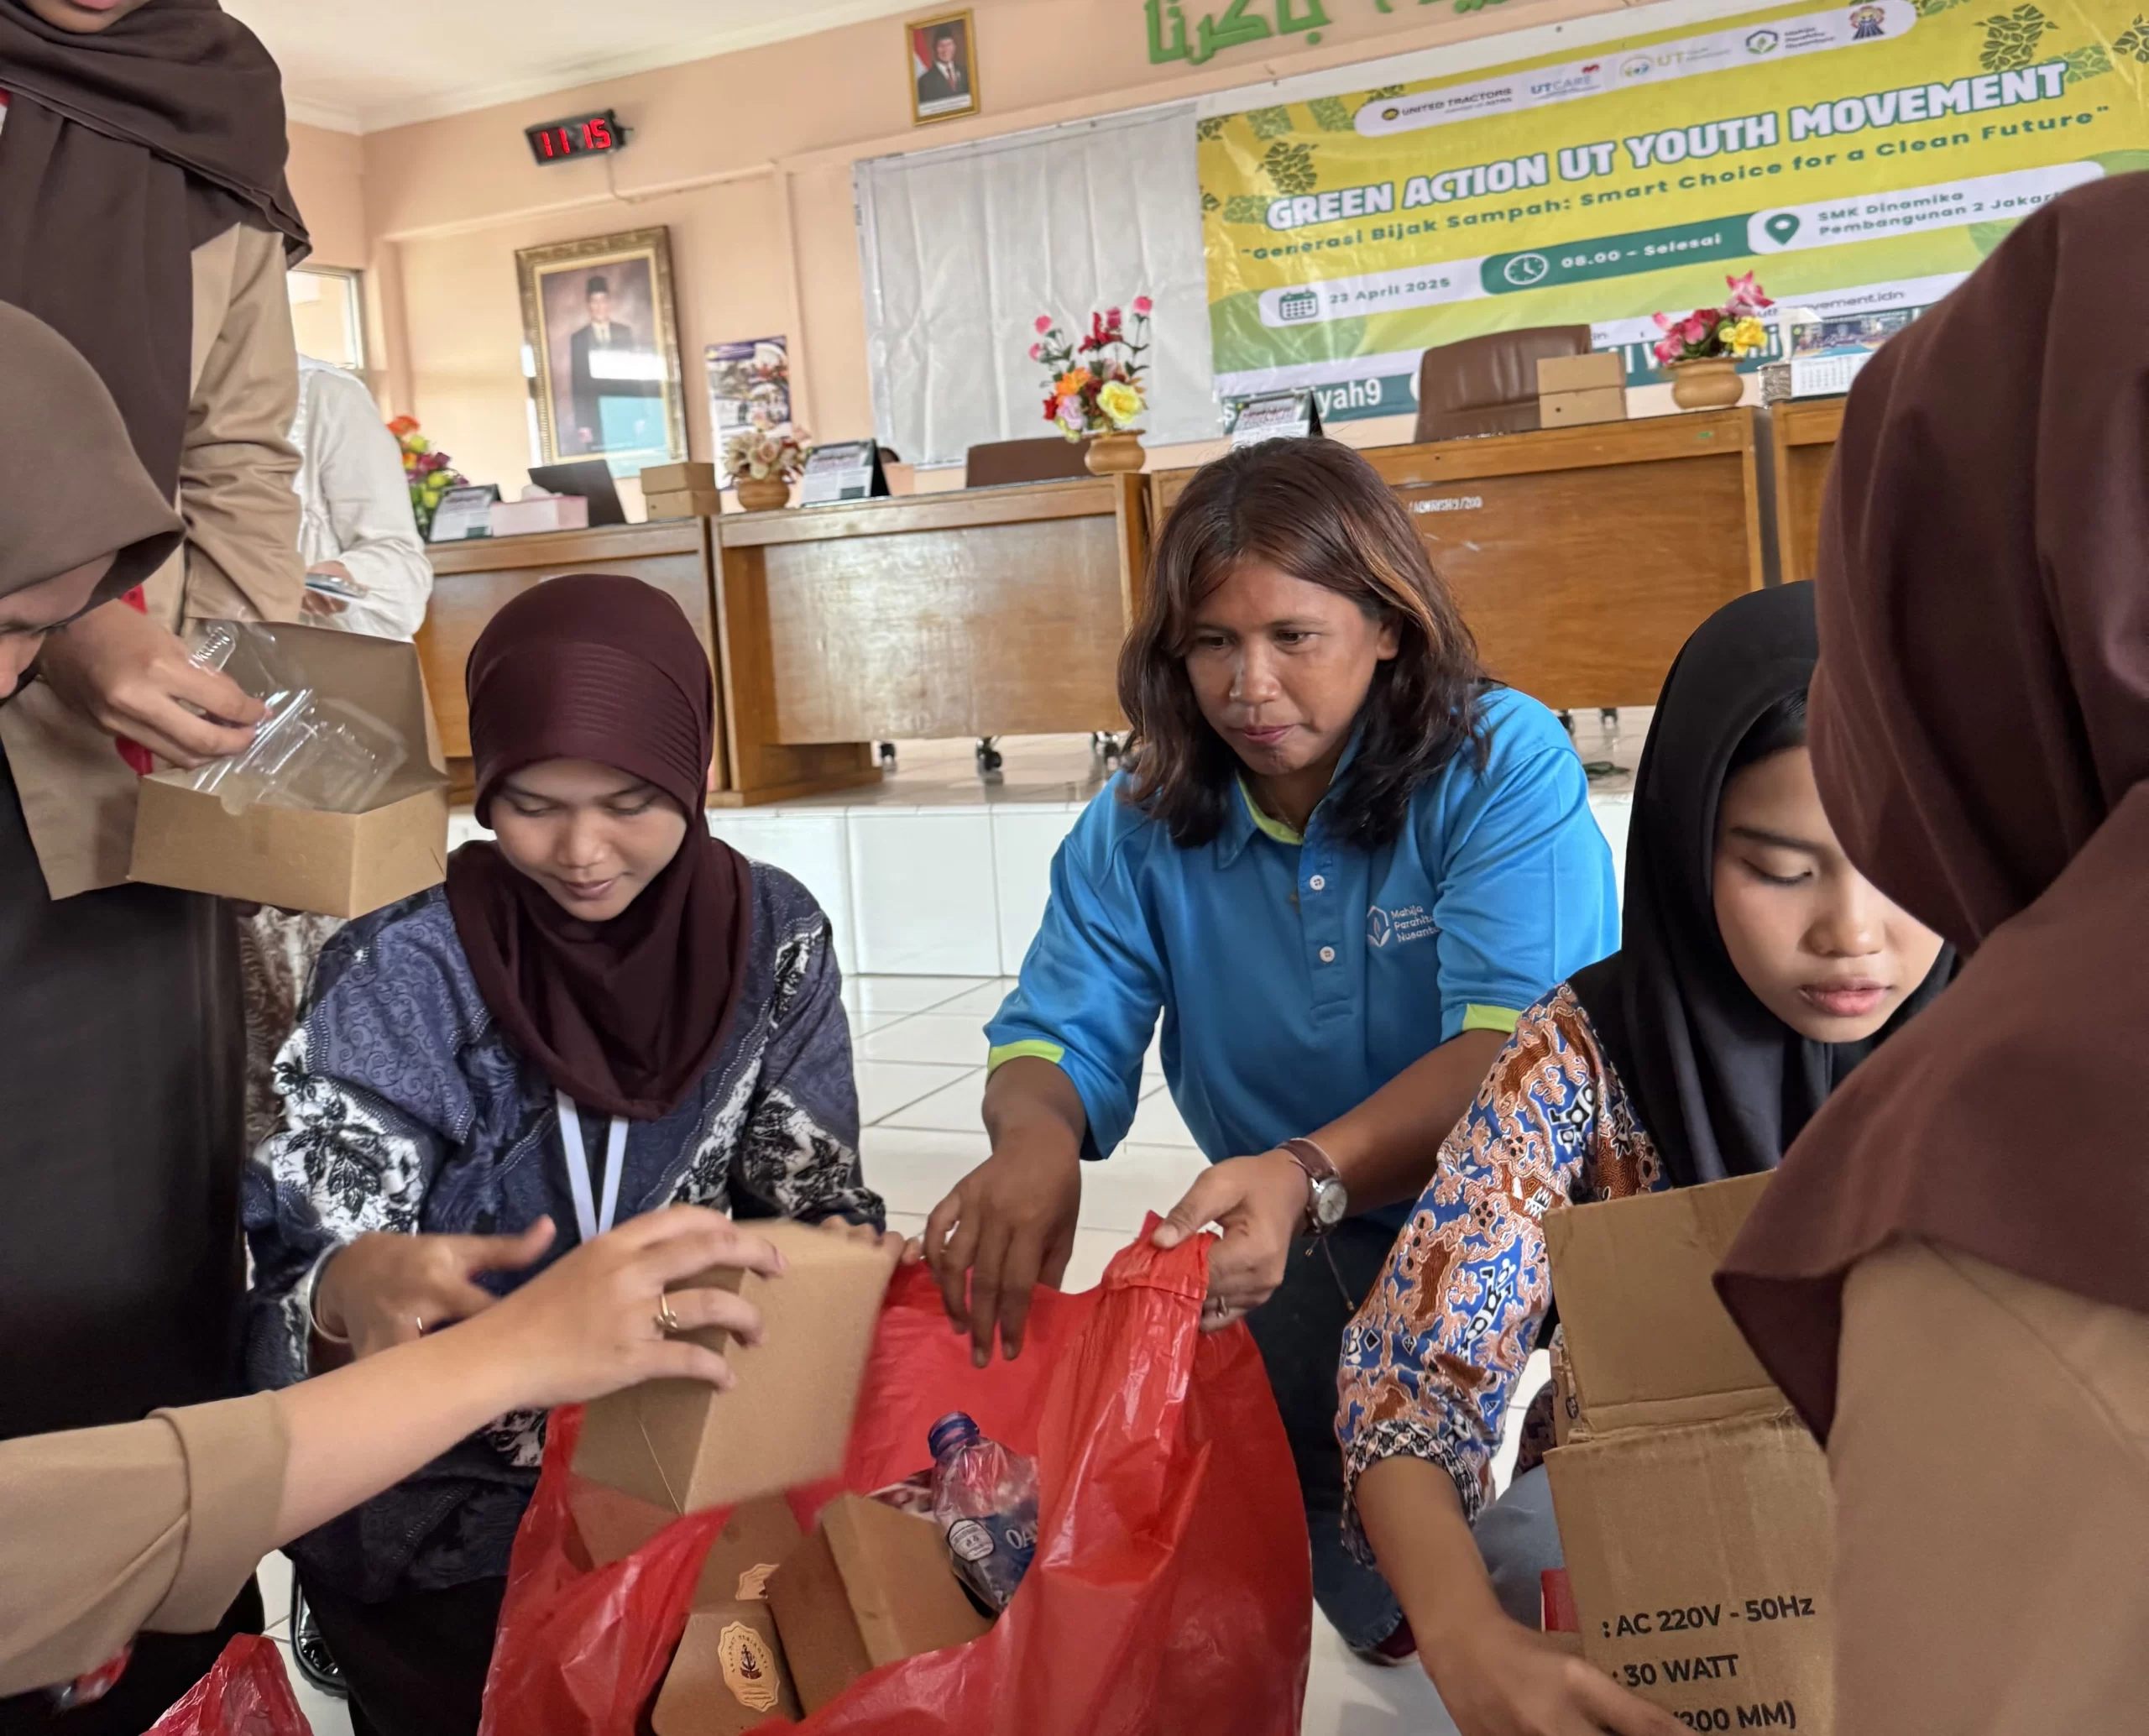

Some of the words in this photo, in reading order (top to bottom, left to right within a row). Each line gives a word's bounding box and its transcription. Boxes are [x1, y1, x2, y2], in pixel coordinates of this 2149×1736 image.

[1401, 101, 1445, 116] UNITED
[1447, 87, 1513, 107] TRACTORS
[1267, 182, 1395, 232] GREEN
[1402, 152, 1549, 210] ACTION
[1557, 140, 1617, 182] UT
[1624, 111, 1779, 169] YOUTH
[1788, 60, 2069, 142] MOVEMENT
[1371, 219, 1437, 241] Bijak
[1446, 198, 1572, 228] Sampah:
[1580, 180, 1669, 207] Smart
[1678, 161, 1782, 190] Choice
[1793, 152, 1838, 171] for
[1847, 149, 1864, 162] a
[1875, 132, 1970, 157] Clean
[1981, 105, 2110, 140] Future"
[1817, 207, 1859, 222] SMK
[1865, 191, 1964, 215] Dinamika
[1818, 204, 1968, 236] Pembangunan
[1972, 201, 1984, 213] 2
[1561, 249, 1621, 269] 08.00
[1643, 232, 1722, 256] Selesai
[1355, 285, 1400, 301] April
[1404, 277, 1451, 293] 2025
[1656, 1604, 1721, 1633] 220V
[1745, 1595, 1815, 1623] 50Hz
[1624, 1662, 1657, 1687] 30
[1661, 1653, 1739, 1684] WATT
[1736, 1699, 1796, 1730] MM)
